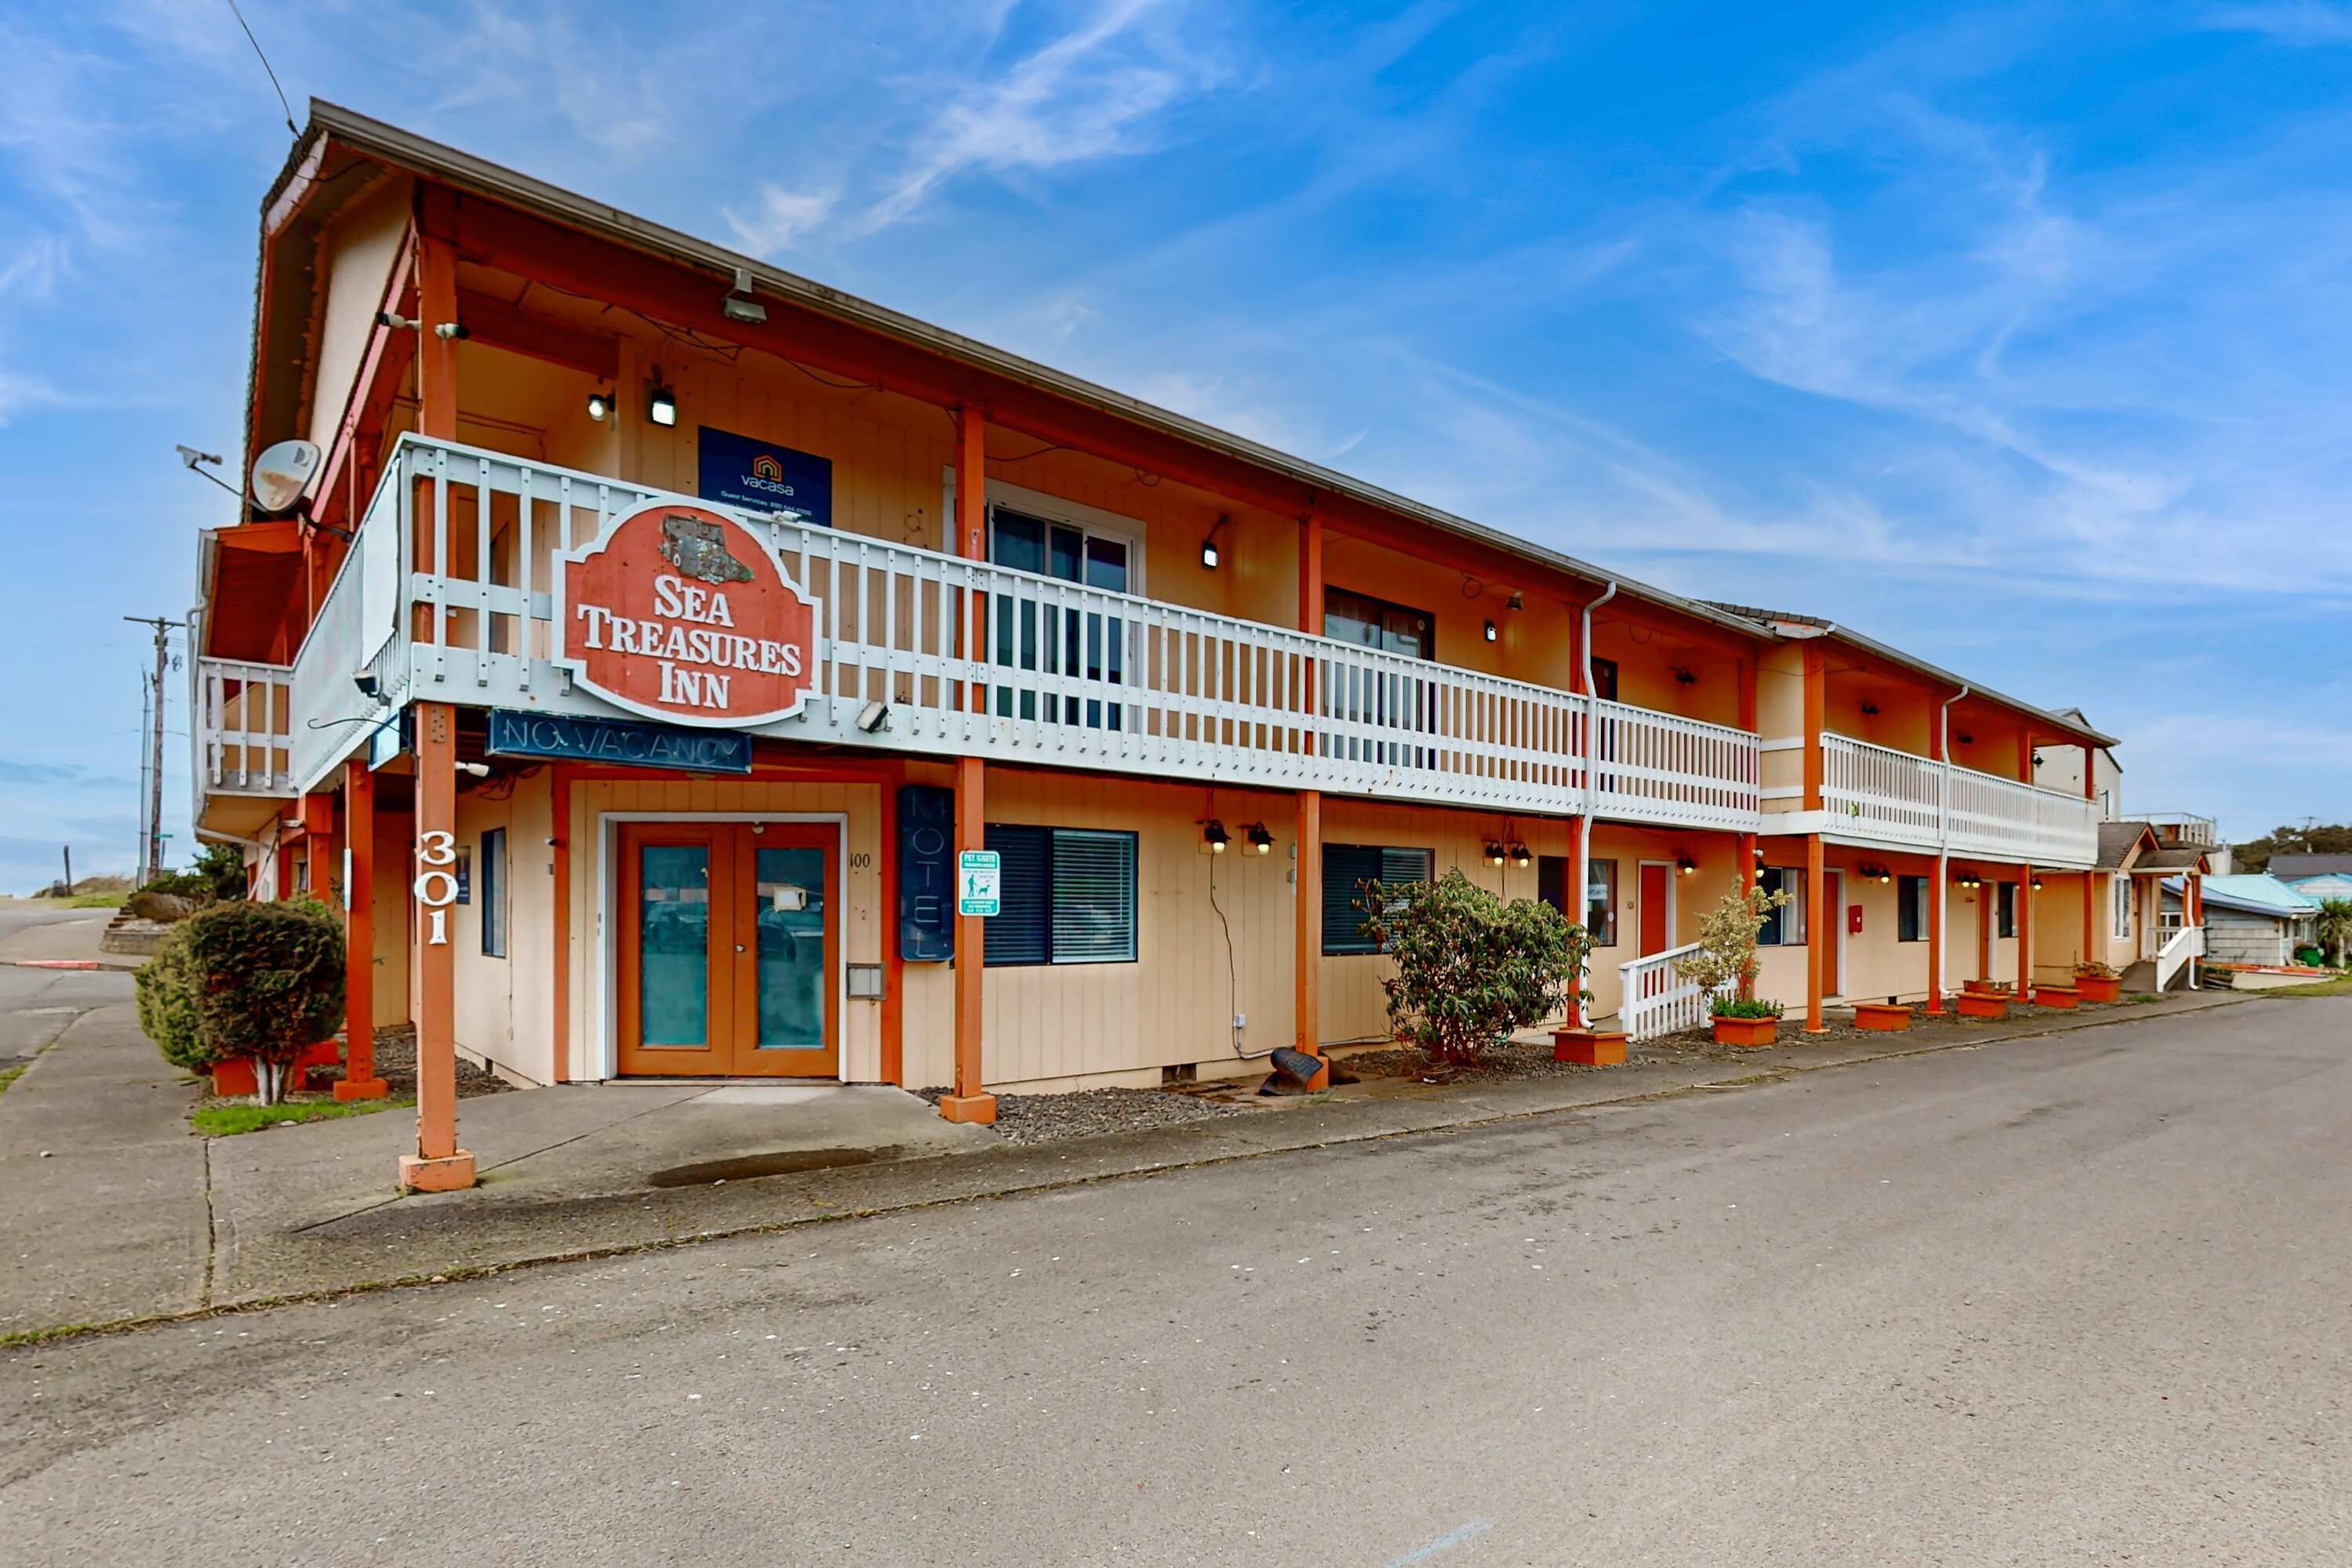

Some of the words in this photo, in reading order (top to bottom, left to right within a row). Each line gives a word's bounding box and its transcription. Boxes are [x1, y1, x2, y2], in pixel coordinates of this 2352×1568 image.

[720, 490, 740, 500] Guest
[741, 474, 794, 496] vacasa
[654, 575, 735, 627] SEA
[577, 604, 801, 677] TREASURES
[658, 660, 731, 710] INN
[503, 718, 562, 750] NO
[575, 726, 739, 767] VACANCY
[850, 852, 870, 869] 100
[912, 793, 946, 958] MOTEL
[414, 830, 459, 945] 301
